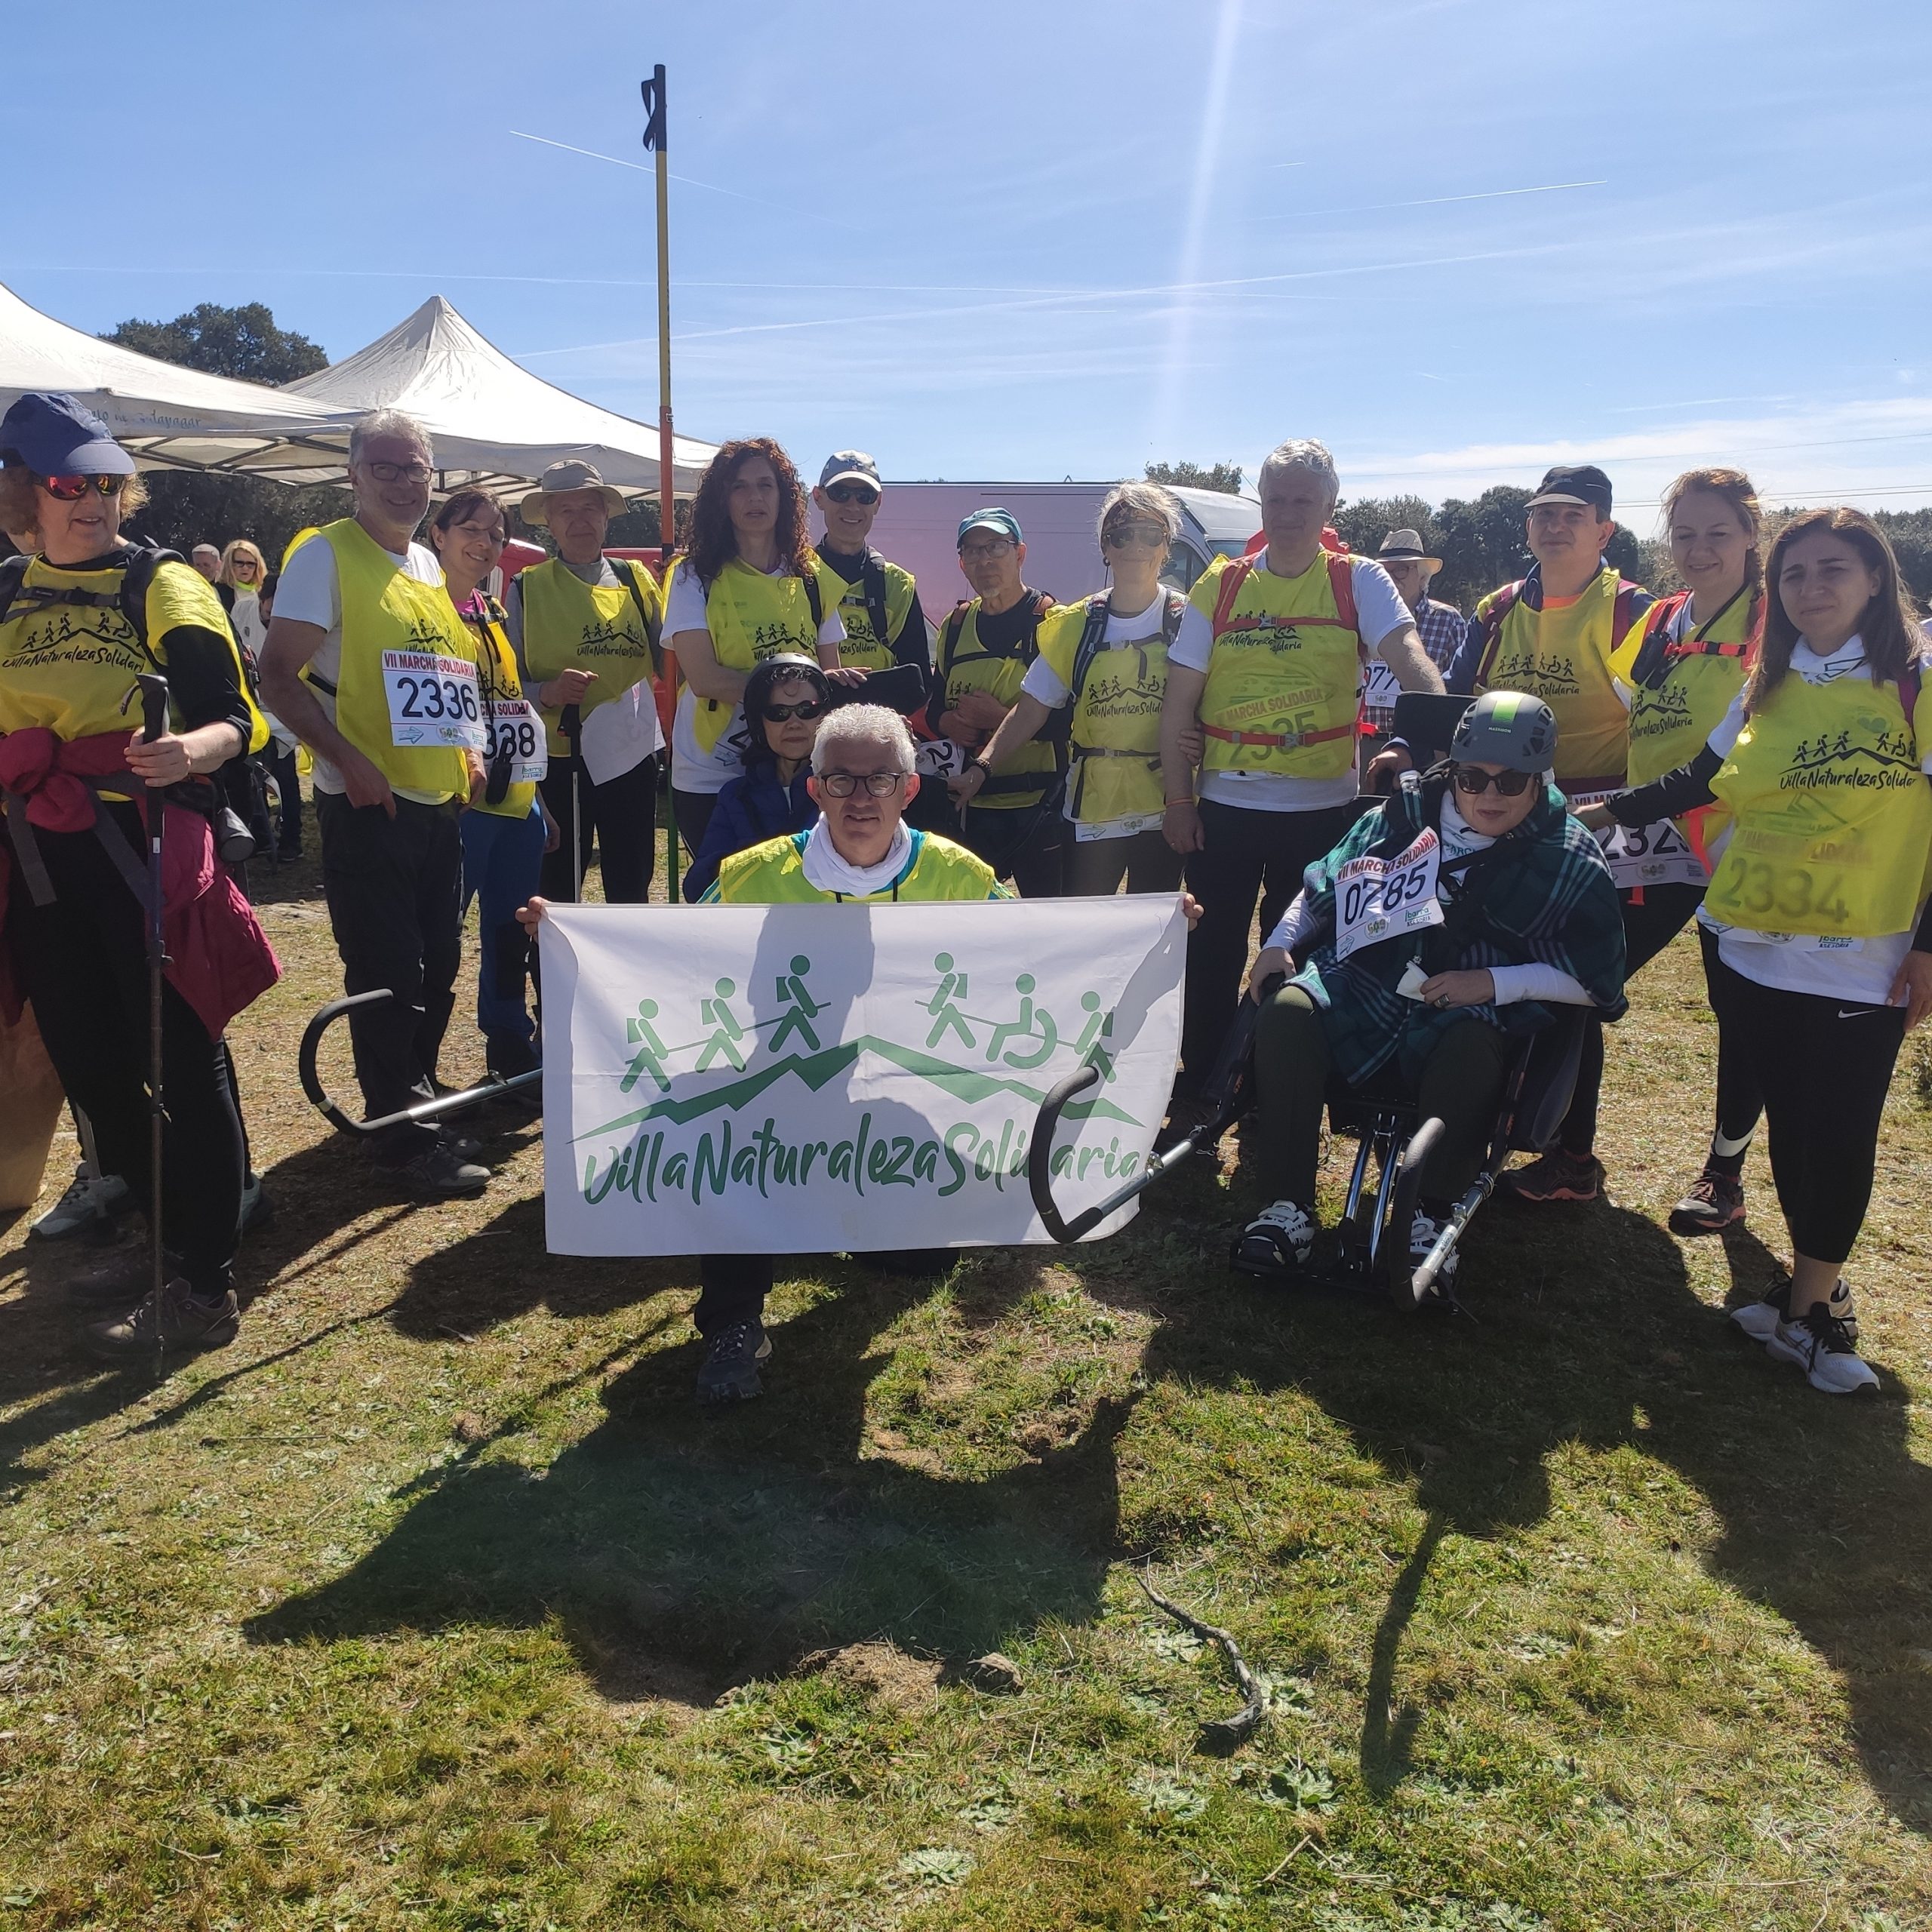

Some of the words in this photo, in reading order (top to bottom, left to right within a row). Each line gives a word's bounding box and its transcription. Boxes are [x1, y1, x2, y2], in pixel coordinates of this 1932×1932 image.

[384, 652, 397, 668] VII
[398, 654, 437, 670] MARCHA
[438, 659, 475, 679] SOLIDARIA
[397, 677, 478, 722] 2336
[1226, 700, 1267, 722] MARCHA
[1268, 688, 1324, 712] SOLIDARIA
[1337, 866, 1349, 881] VII
[1350, 859, 1395, 875] MARCHA
[1396, 832, 1437, 869] SOLIDARIA
[1344, 860, 1429, 925] 0785
[1719, 857, 1850, 924] 2334
[584, 1112, 1140, 1205] VillaNaturalezaSoliaria
